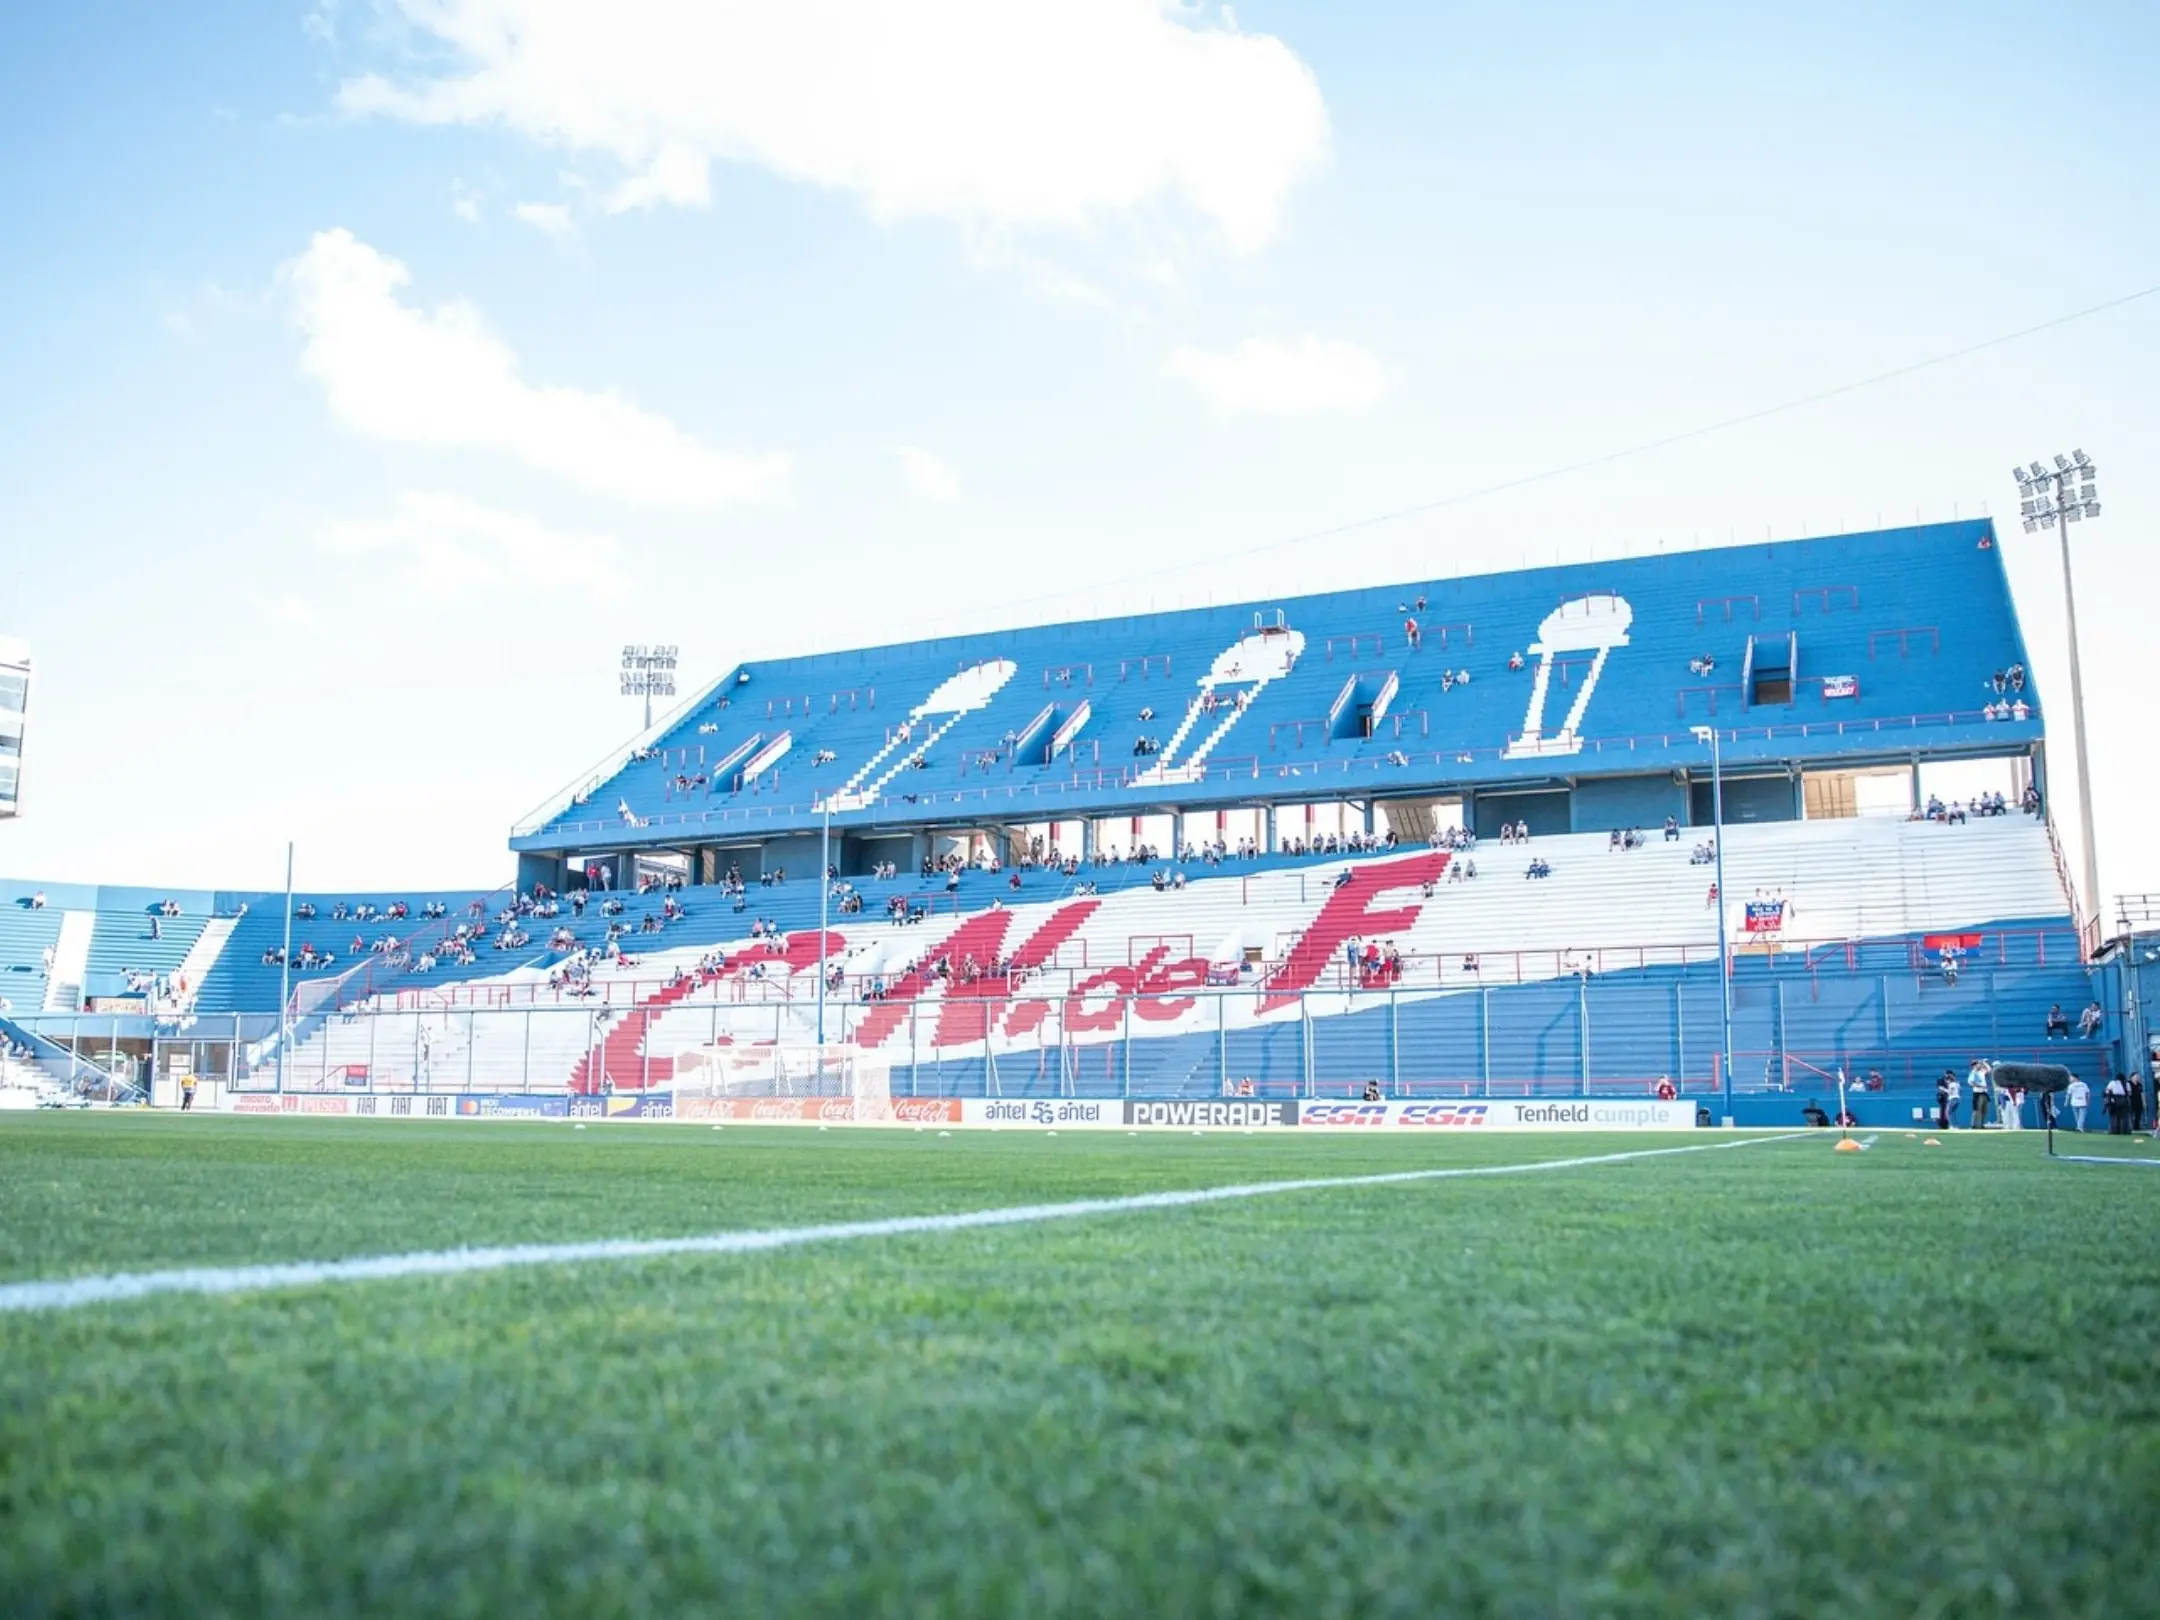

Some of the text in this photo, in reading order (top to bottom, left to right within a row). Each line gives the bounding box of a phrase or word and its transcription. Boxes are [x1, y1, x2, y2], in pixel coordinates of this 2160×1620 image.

[357, 1097, 377, 1114] FIAT
[391, 1097, 412, 1115] FIAT
[426, 1097, 448, 1115] FIAT
[570, 1100, 602, 1117] antel
[641, 1100, 676, 1118] ante
[895, 1099, 953, 1122] Coca-Cola
[985, 1100, 1027, 1120] antel
[1058, 1101, 1100, 1120] antel
[1133, 1102, 1283, 1125] POWERADE
[1514, 1103, 1670, 1126] Tenfield cumple
